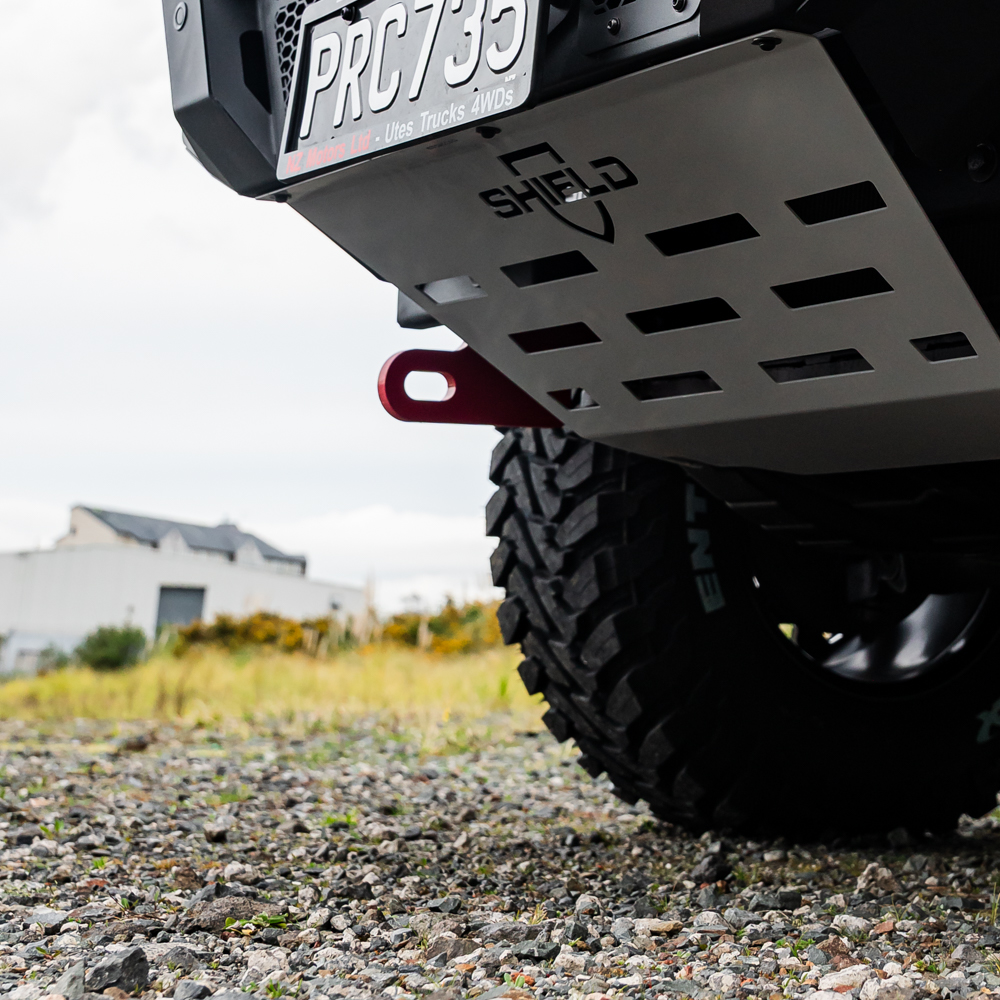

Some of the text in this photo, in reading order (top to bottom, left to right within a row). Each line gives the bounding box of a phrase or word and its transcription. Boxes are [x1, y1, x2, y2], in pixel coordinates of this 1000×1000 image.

[286, 152, 302, 174] NZ
[306, 141, 346, 168] Motors
[350, 130, 371, 152] Ltd
[385, 119, 414, 144] Utes
[420, 104, 465, 133] Trucks
[471, 86, 514, 116] 4WDs
[478, 156, 639, 219] SHIELD
